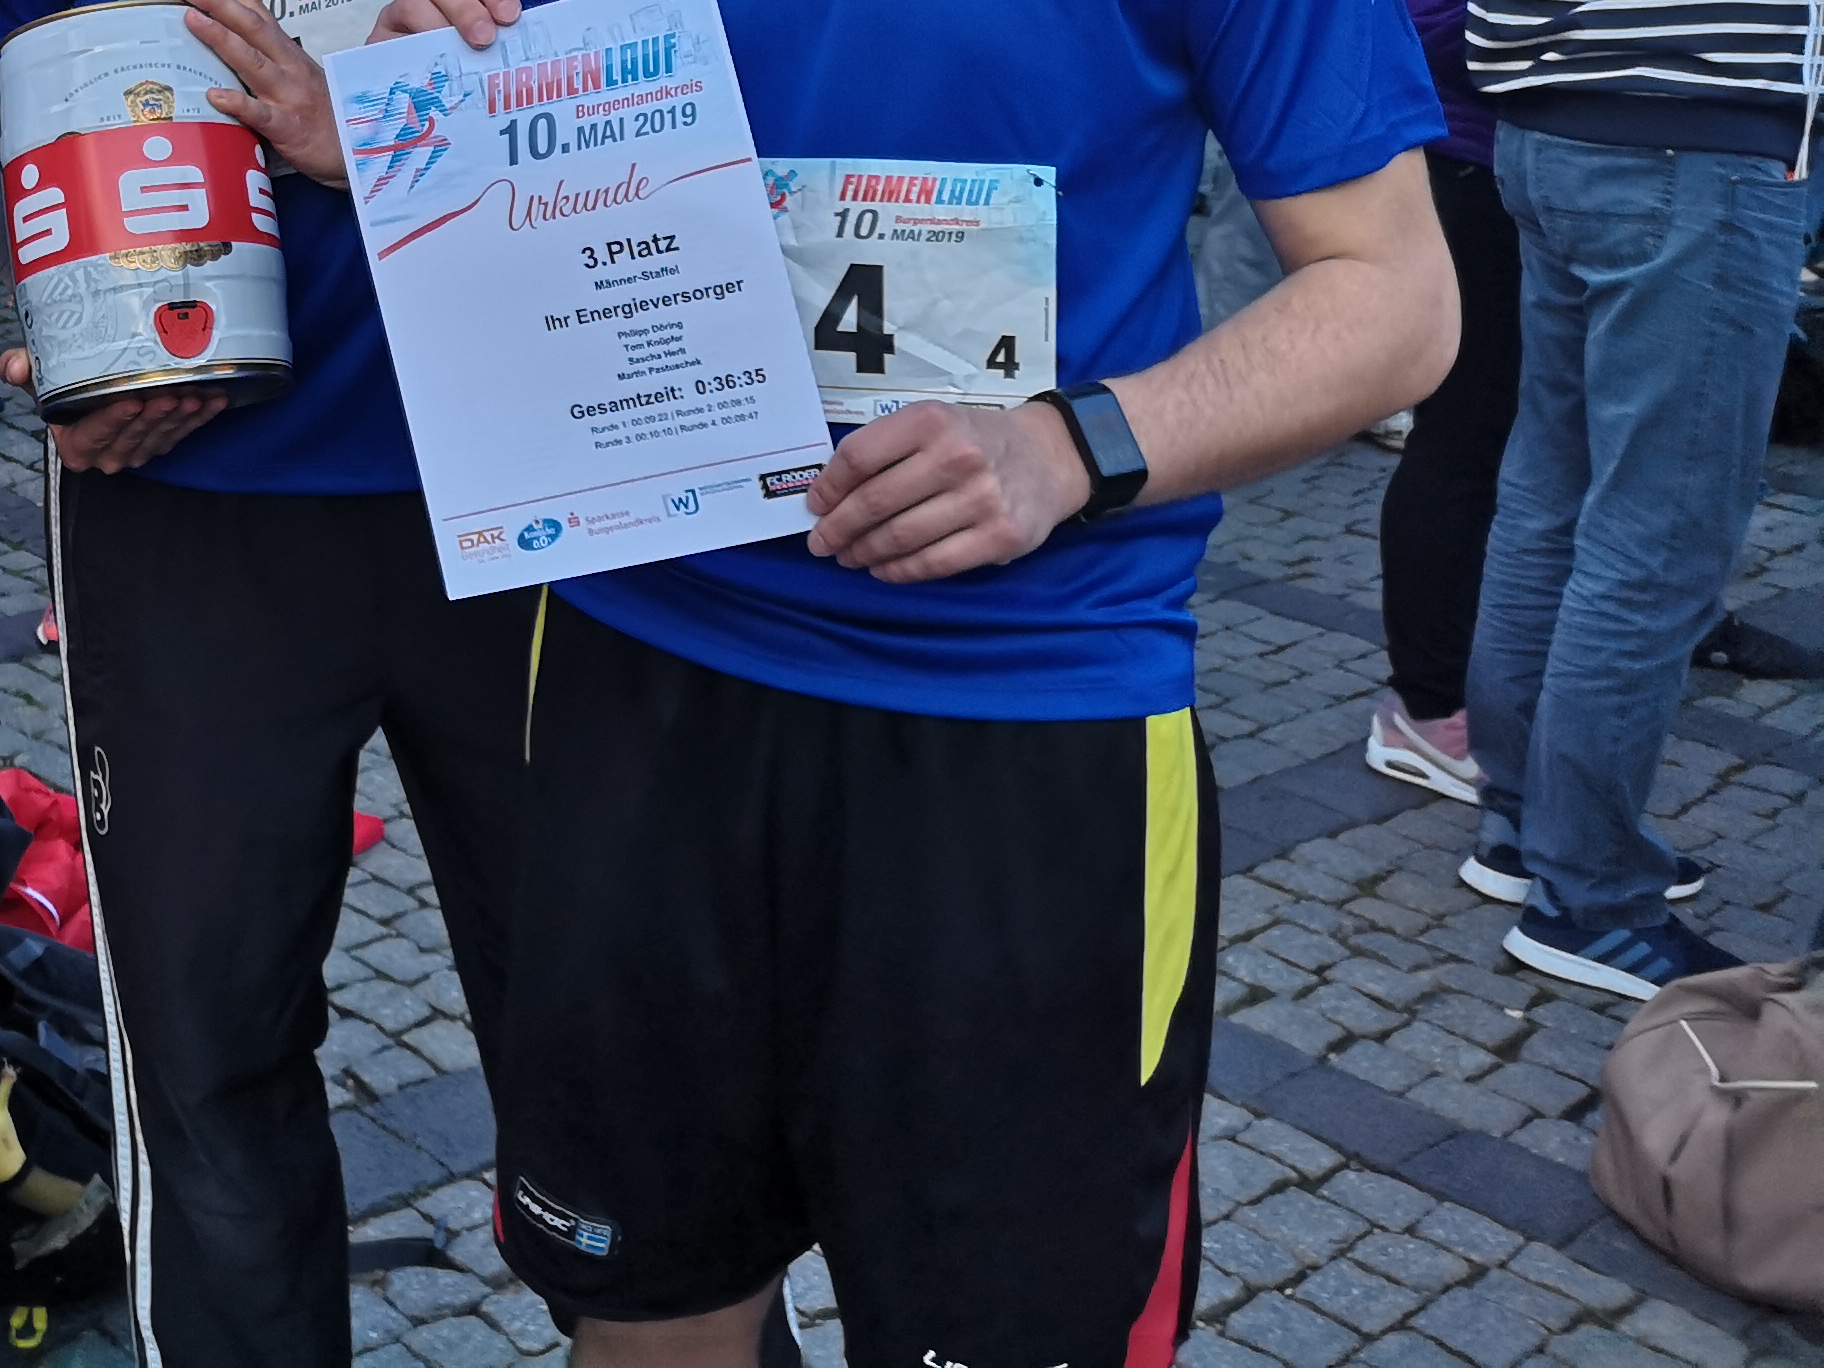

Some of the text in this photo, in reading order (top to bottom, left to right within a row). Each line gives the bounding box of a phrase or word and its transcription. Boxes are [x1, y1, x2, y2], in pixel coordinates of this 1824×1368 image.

[299, 0, 322, 16] MAI
[486, 32, 678, 116] FIRMENLAUF
[576, 79, 703, 120] Burgenlandkreis
[499, 101, 698, 166] 10. MAI 2019
[498, 162, 652, 232] Urkunde
[839, 173, 1000, 207] FIRMENLAUF
[833, 208, 965, 244] 10. MAI 2019
[581, 233, 680, 269] 3.Platz
[594, 264, 680, 291] Männer-Staffel
[544, 279, 745, 332] Ihr Energieversorger
[814, 263, 896, 375] 4
[623, 342, 645, 353] Tom
[986, 334, 1020, 380] 4
[570, 367, 768, 420] Gesamtzeit: 0:36:35
